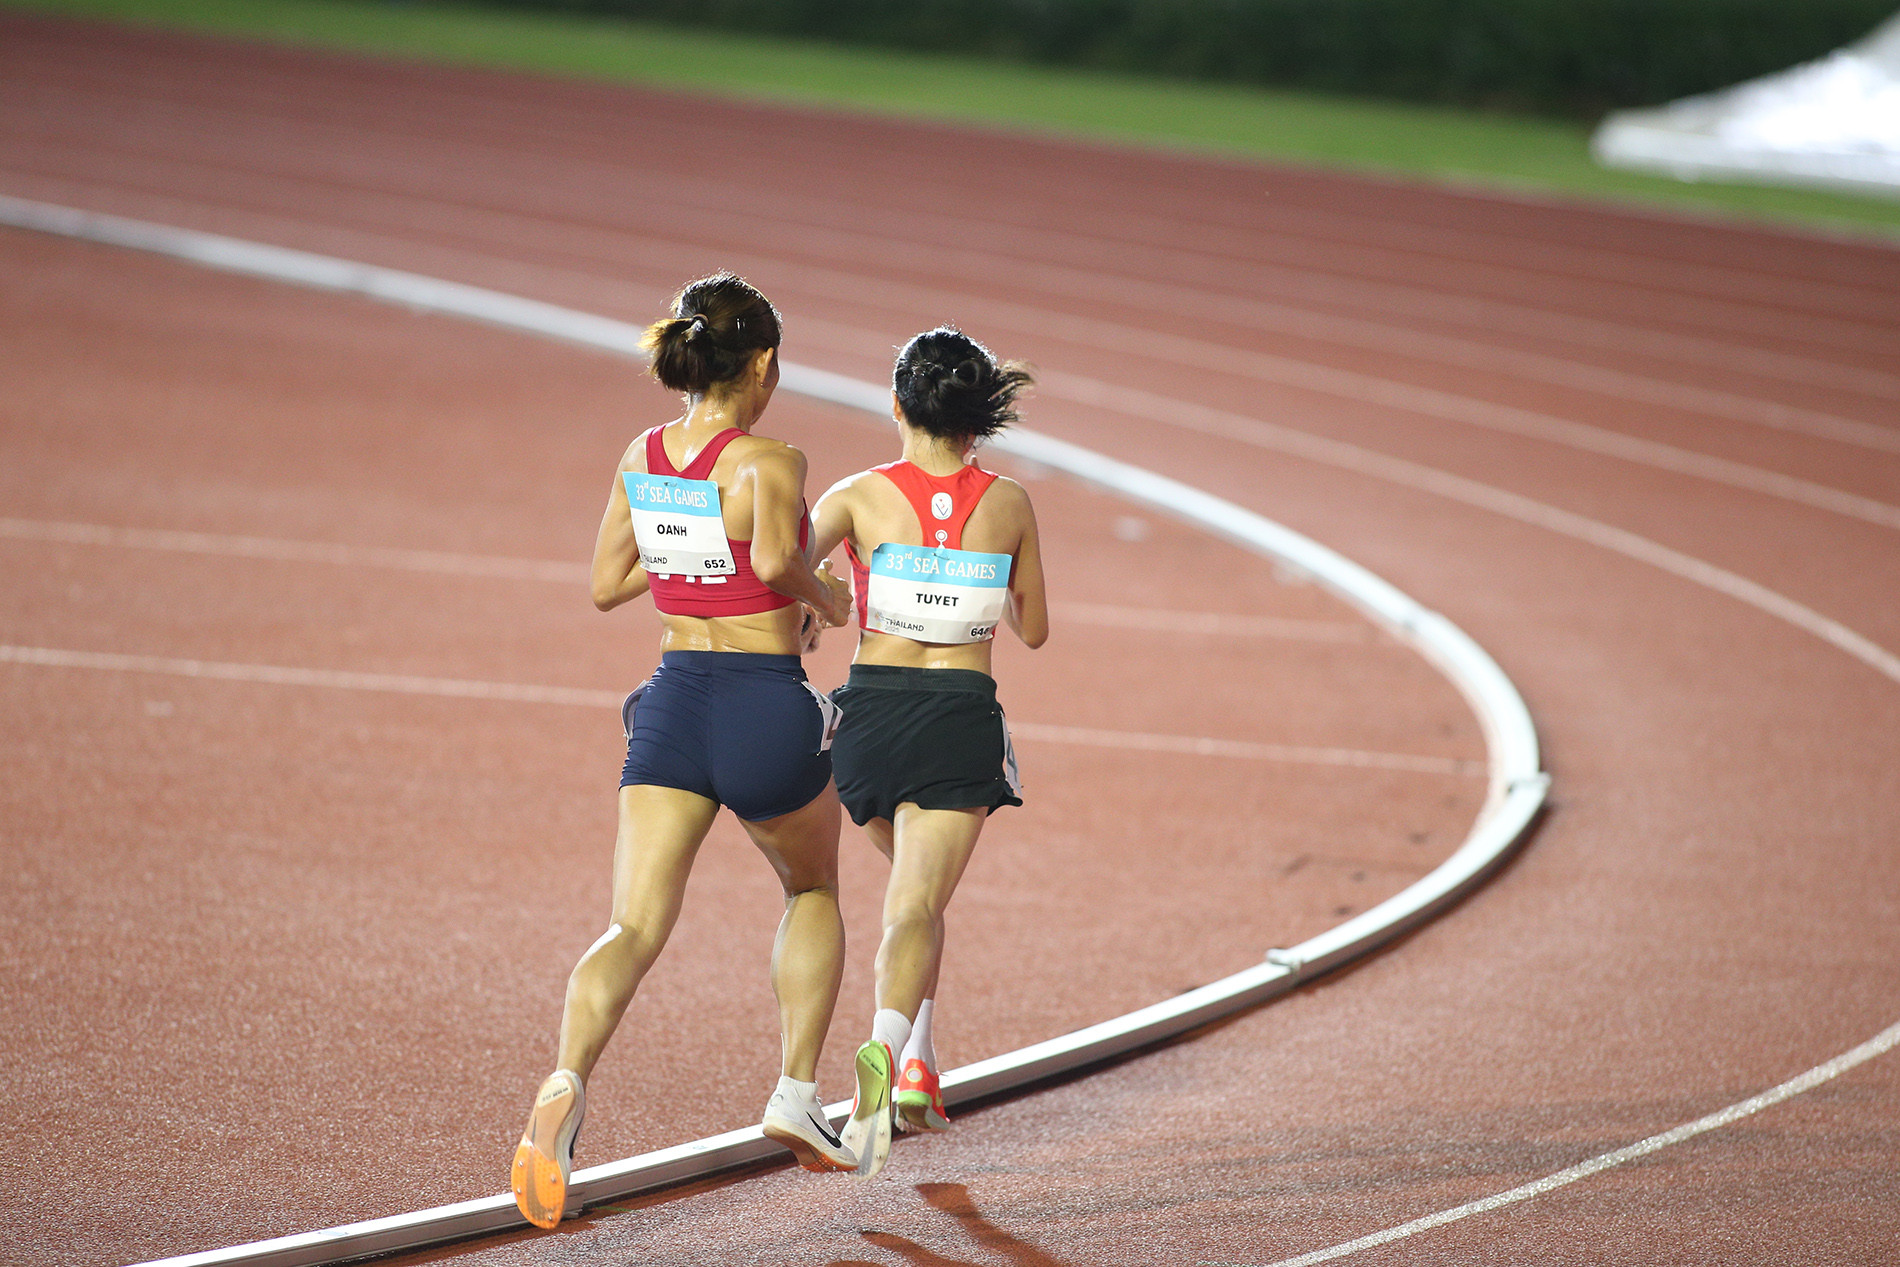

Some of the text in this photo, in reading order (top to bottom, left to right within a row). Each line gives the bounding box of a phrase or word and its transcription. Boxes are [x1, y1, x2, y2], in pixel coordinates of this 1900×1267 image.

[635, 480, 708, 508] 33rd SEA GAMES
[656, 523, 687, 537] OANH
[704, 559, 726, 569] 652
[885, 551, 996, 579] 33rd SEA GAMES
[915, 593, 959, 607] TUYET
[885, 616, 925, 632] THAILAND
